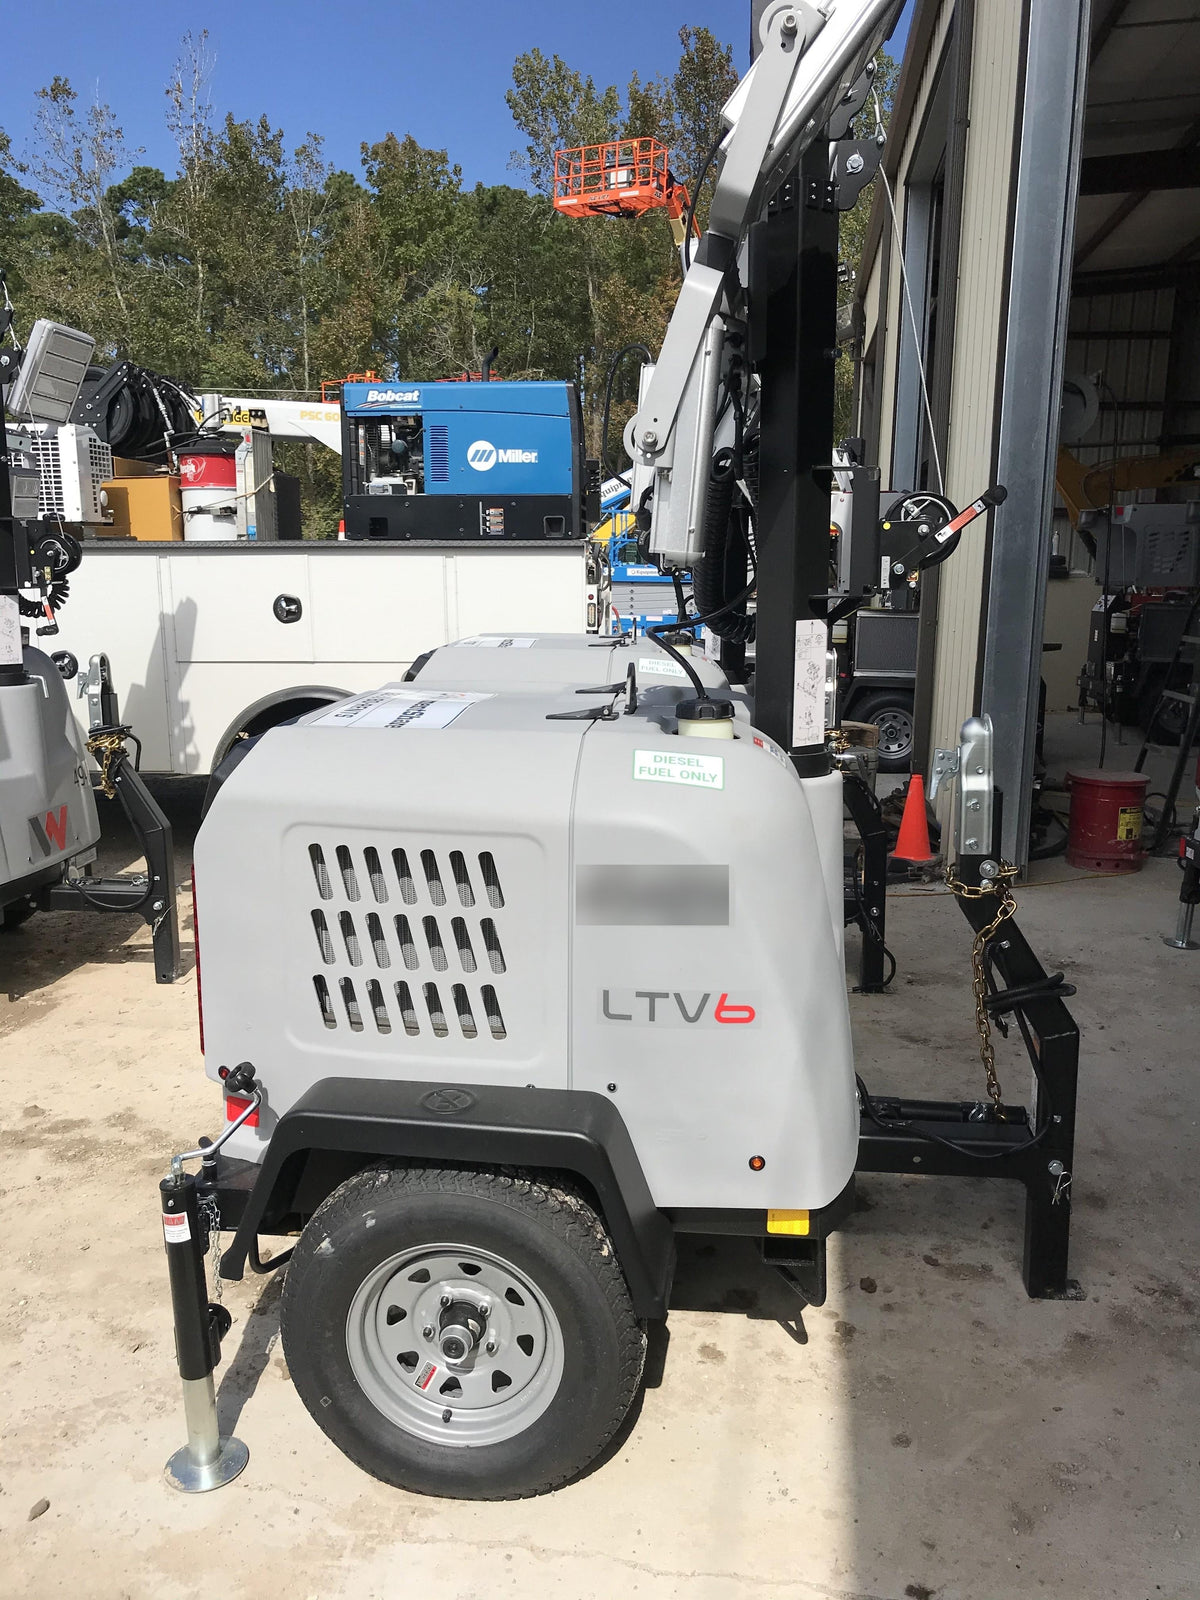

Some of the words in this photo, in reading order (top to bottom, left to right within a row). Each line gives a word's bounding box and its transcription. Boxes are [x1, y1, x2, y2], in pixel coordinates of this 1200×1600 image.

[367, 389, 420, 402] Bobcat
[300, 410, 322, 421] PSC
[498, 448, 538, 463] Miller
[649, 660, 675, 668] DIESEL
[663, 667, 684, 675] ONLY
[653, 754, 704, 769] DIESEL
[638, 765, 676, 779] FUEL
[680, 769, 719, 785] ONLY
[602, 989, 756, 1024] LTV6
